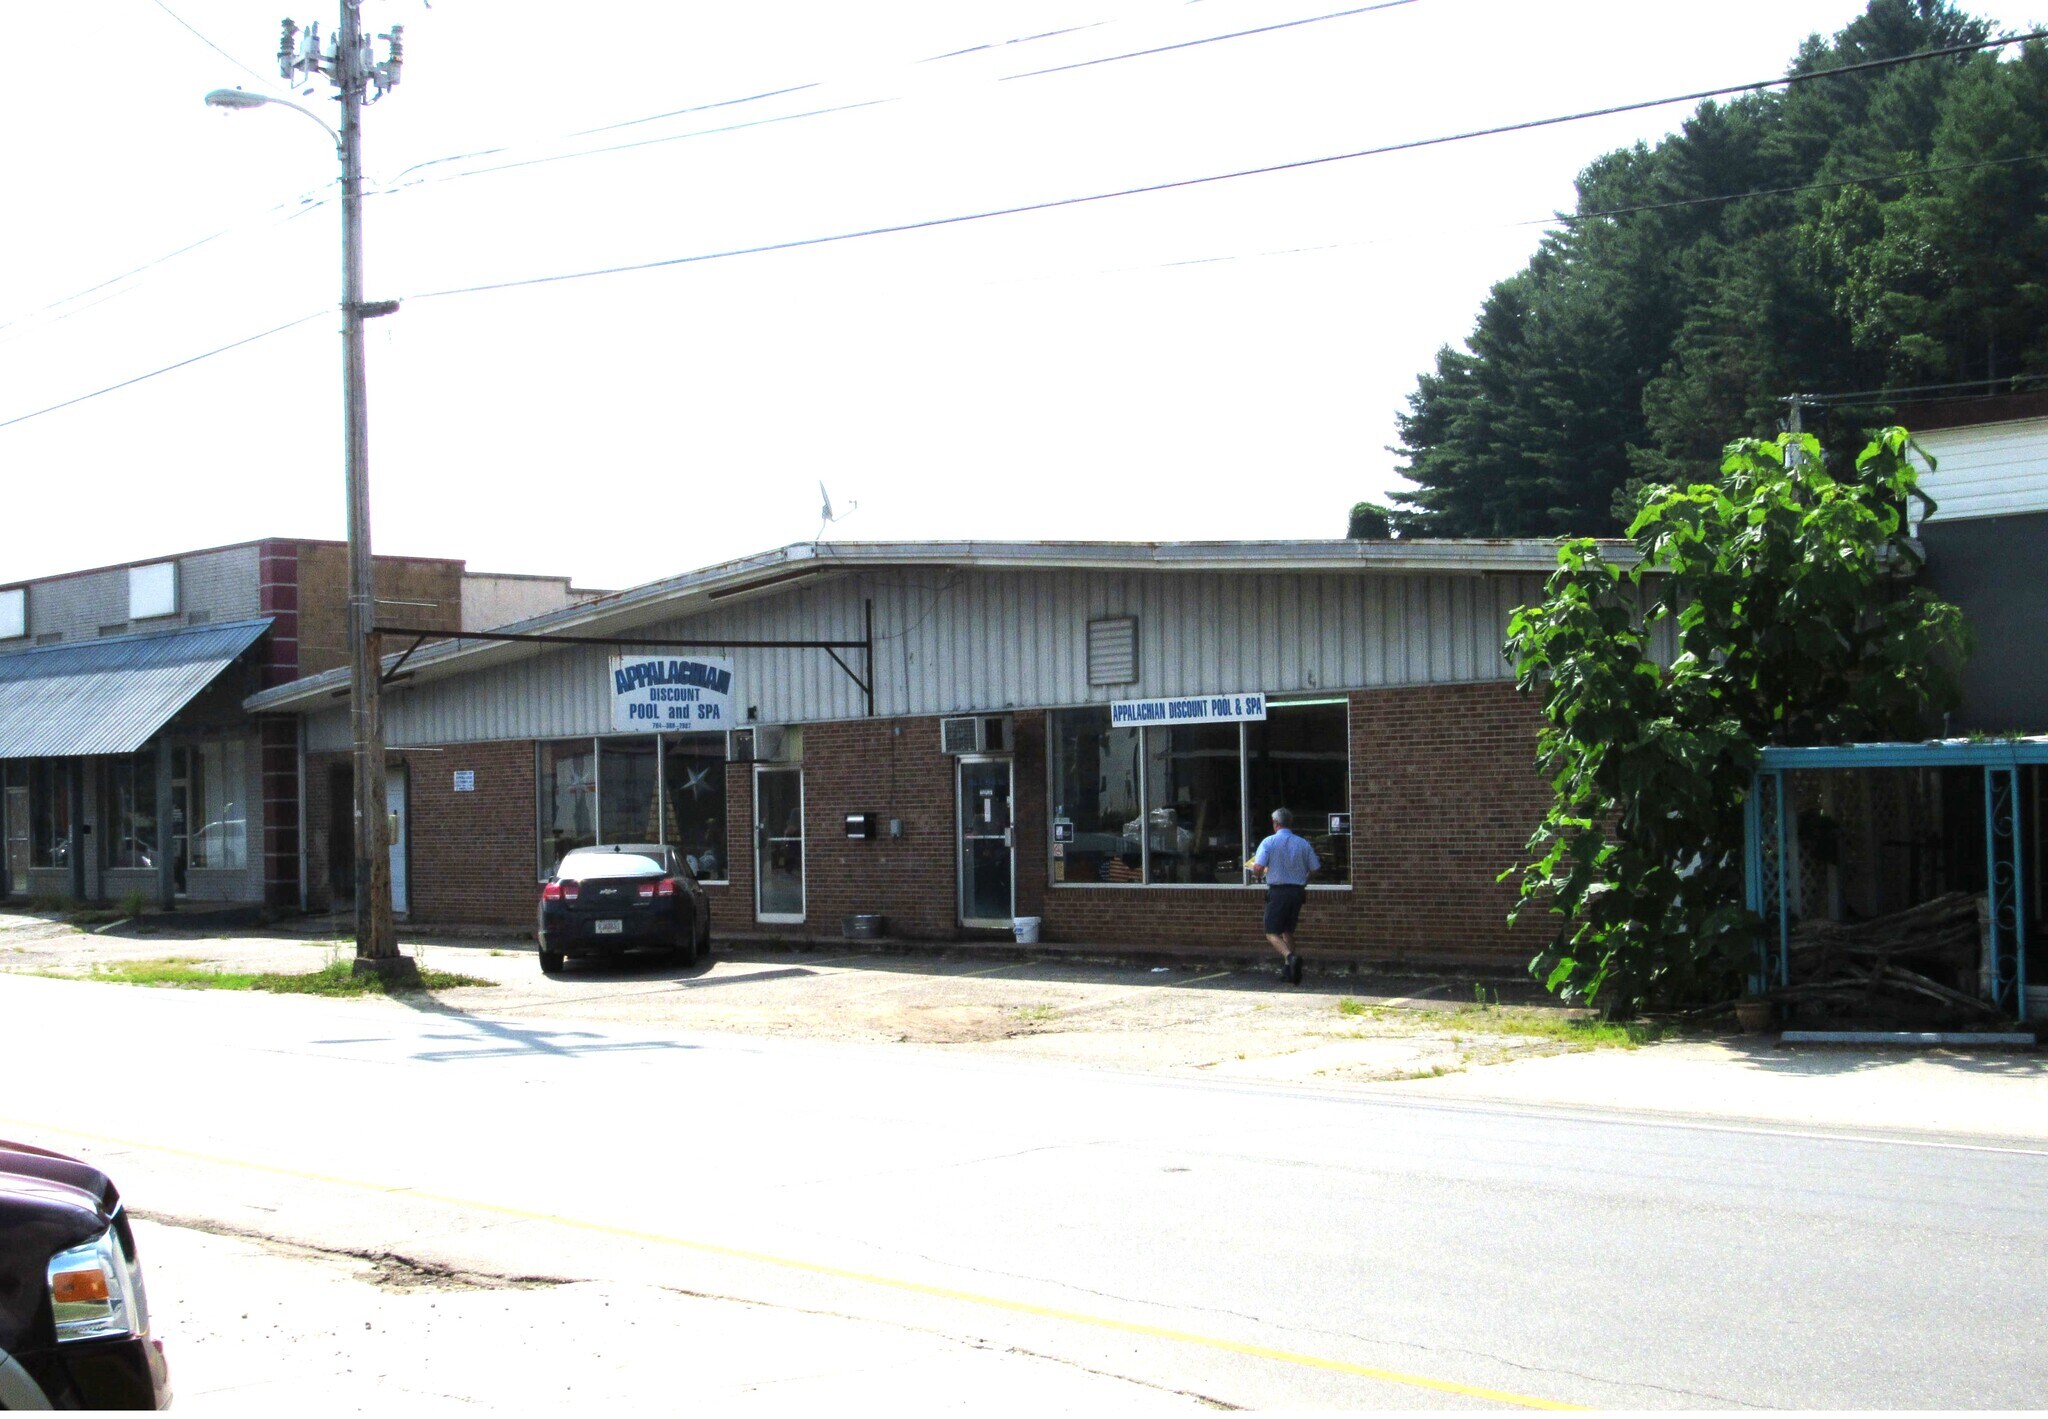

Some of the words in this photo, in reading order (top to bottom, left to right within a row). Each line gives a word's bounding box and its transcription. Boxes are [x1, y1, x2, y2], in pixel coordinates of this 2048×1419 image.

[615, 660, 731, 695] APPALACHIAN
[650, 688, 700, 701] DISCOUNT
[630, 704, 660, 719] POOL
[668, 704, 690, 719] and
[697, 704, 720, 719] SPA
[1113, 703, 1166, 722] APPALACHIAN
[1169, 700, 1208, 719] DISCOUNT
[1211, 698, 1232, 716] POOL
[1235, 698, 1242, 715] &
[1245, 697, 1262, 715] SPA
